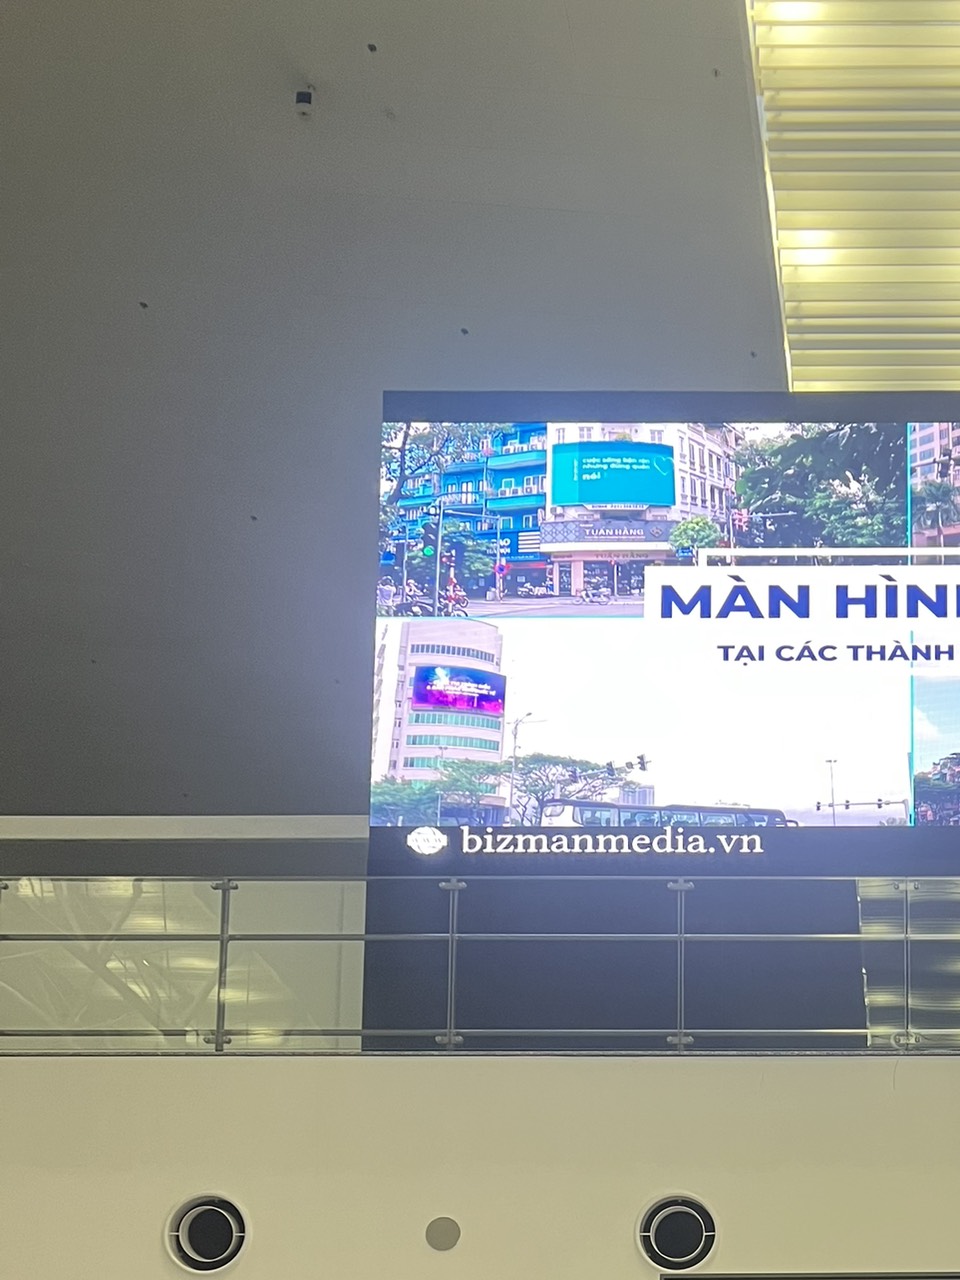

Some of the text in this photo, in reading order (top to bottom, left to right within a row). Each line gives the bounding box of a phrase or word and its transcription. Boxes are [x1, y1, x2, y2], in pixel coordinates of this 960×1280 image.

[660, 574, 810, 618] MÀN
[717, 645, 765, 666] TẠI
[775, 640, 837, 661] CÁC
[846, 640, 954, 661] THÀNH
[460, 826, 764, 854] bizmanmedia.vn
